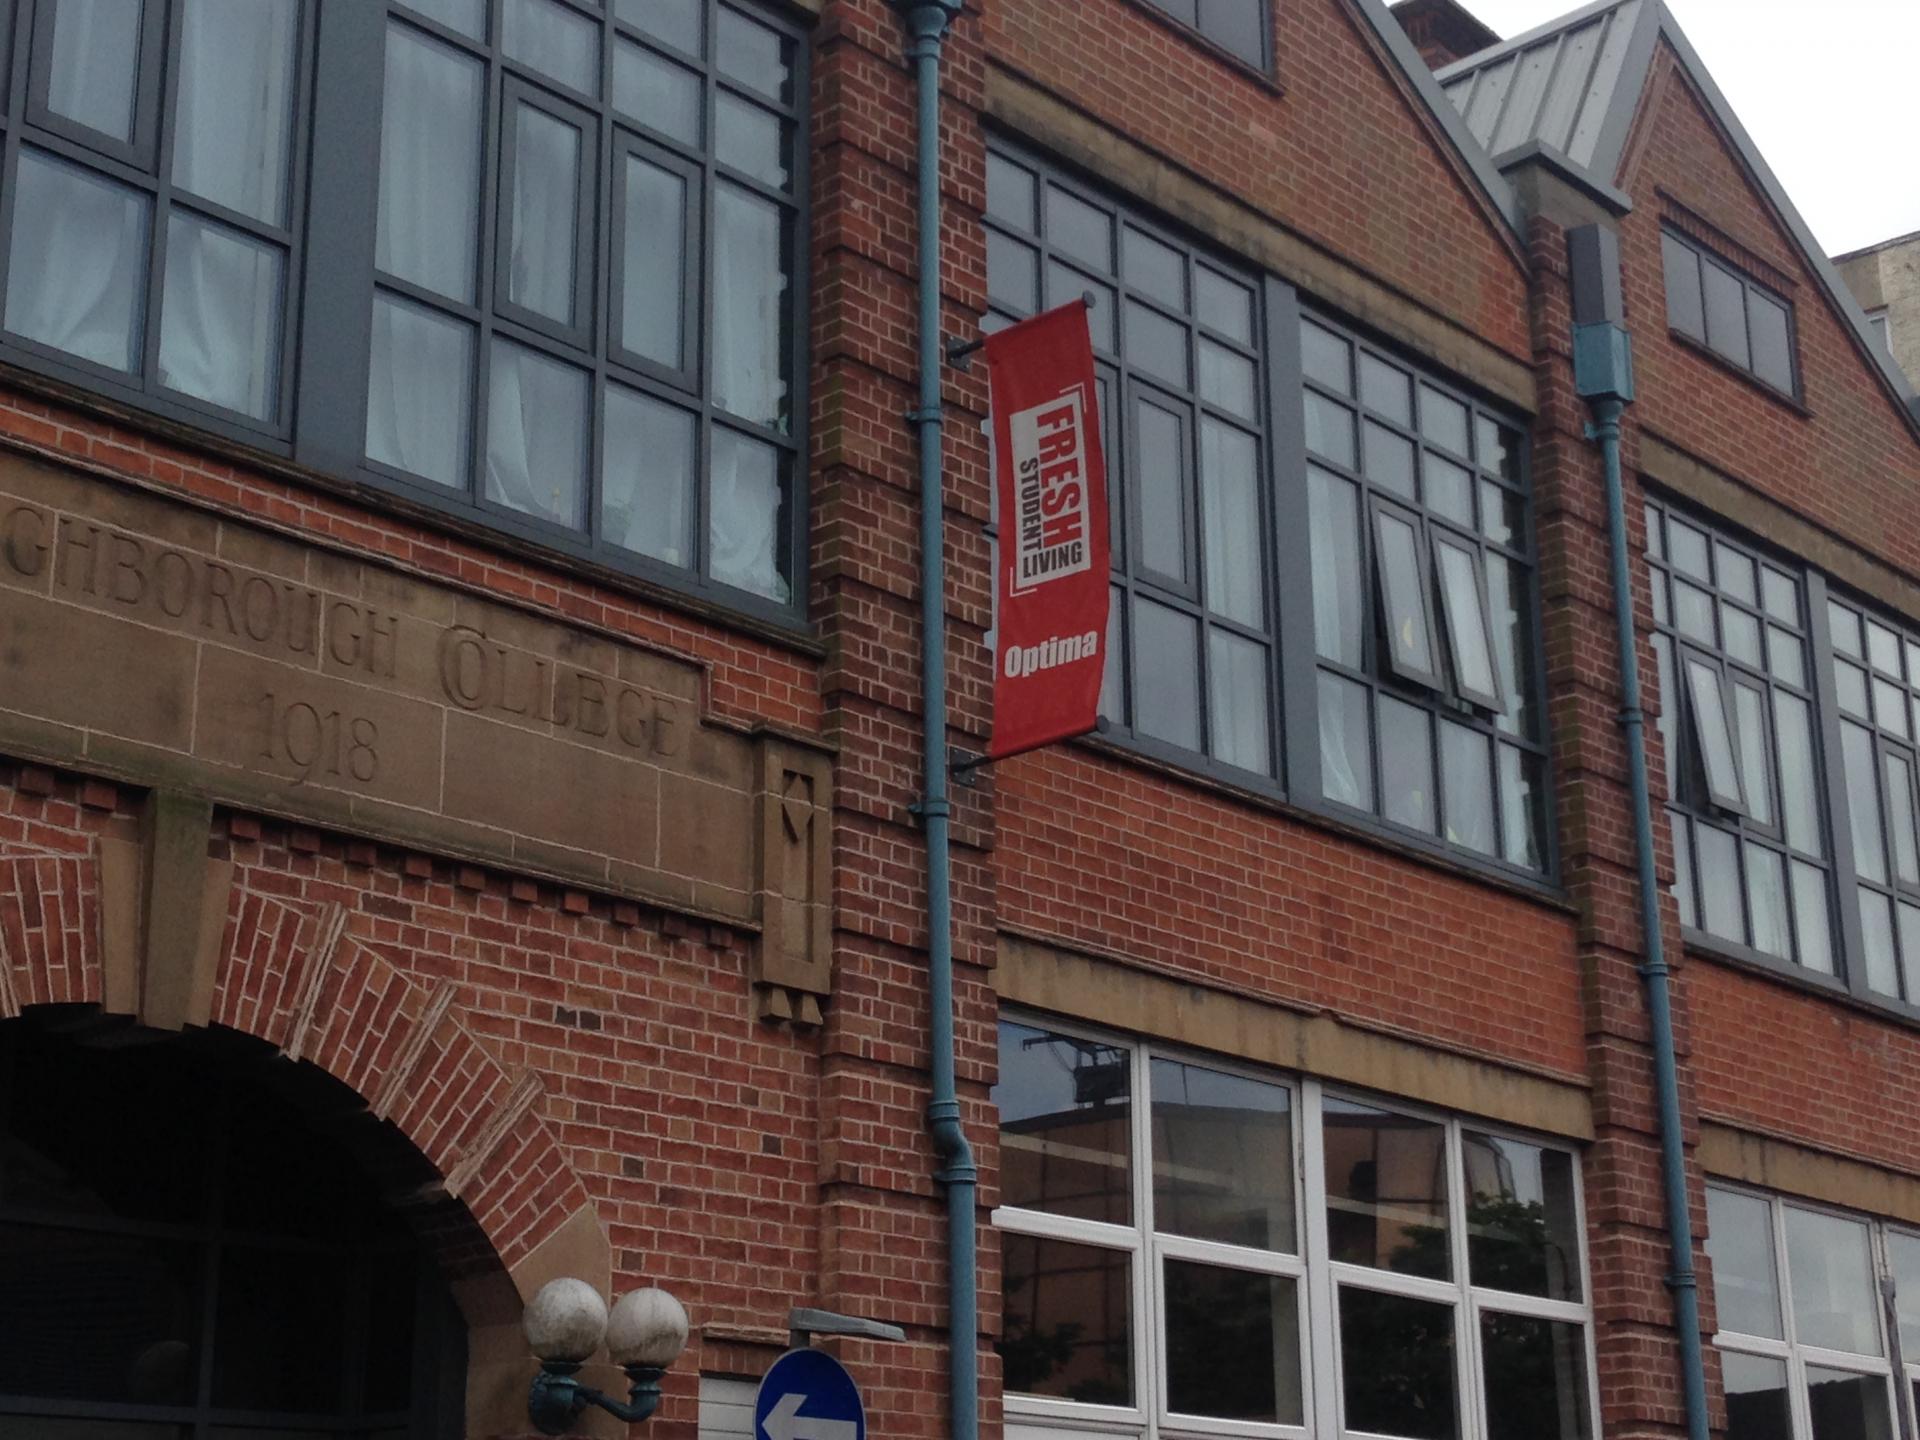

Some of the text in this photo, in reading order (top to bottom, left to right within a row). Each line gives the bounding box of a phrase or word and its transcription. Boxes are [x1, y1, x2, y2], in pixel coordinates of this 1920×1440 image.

[1020, 457, 1042, 552] STUDENT
[1036, 404, 1083, 548] FRESH
[1023, 540, 1083, 579] LIVING
[3, 506, 677, 757] GHBOROUGH COLLEGE
[1005, 631, 1097, 678] Optima
[258, 692, 378, 787] 1918
